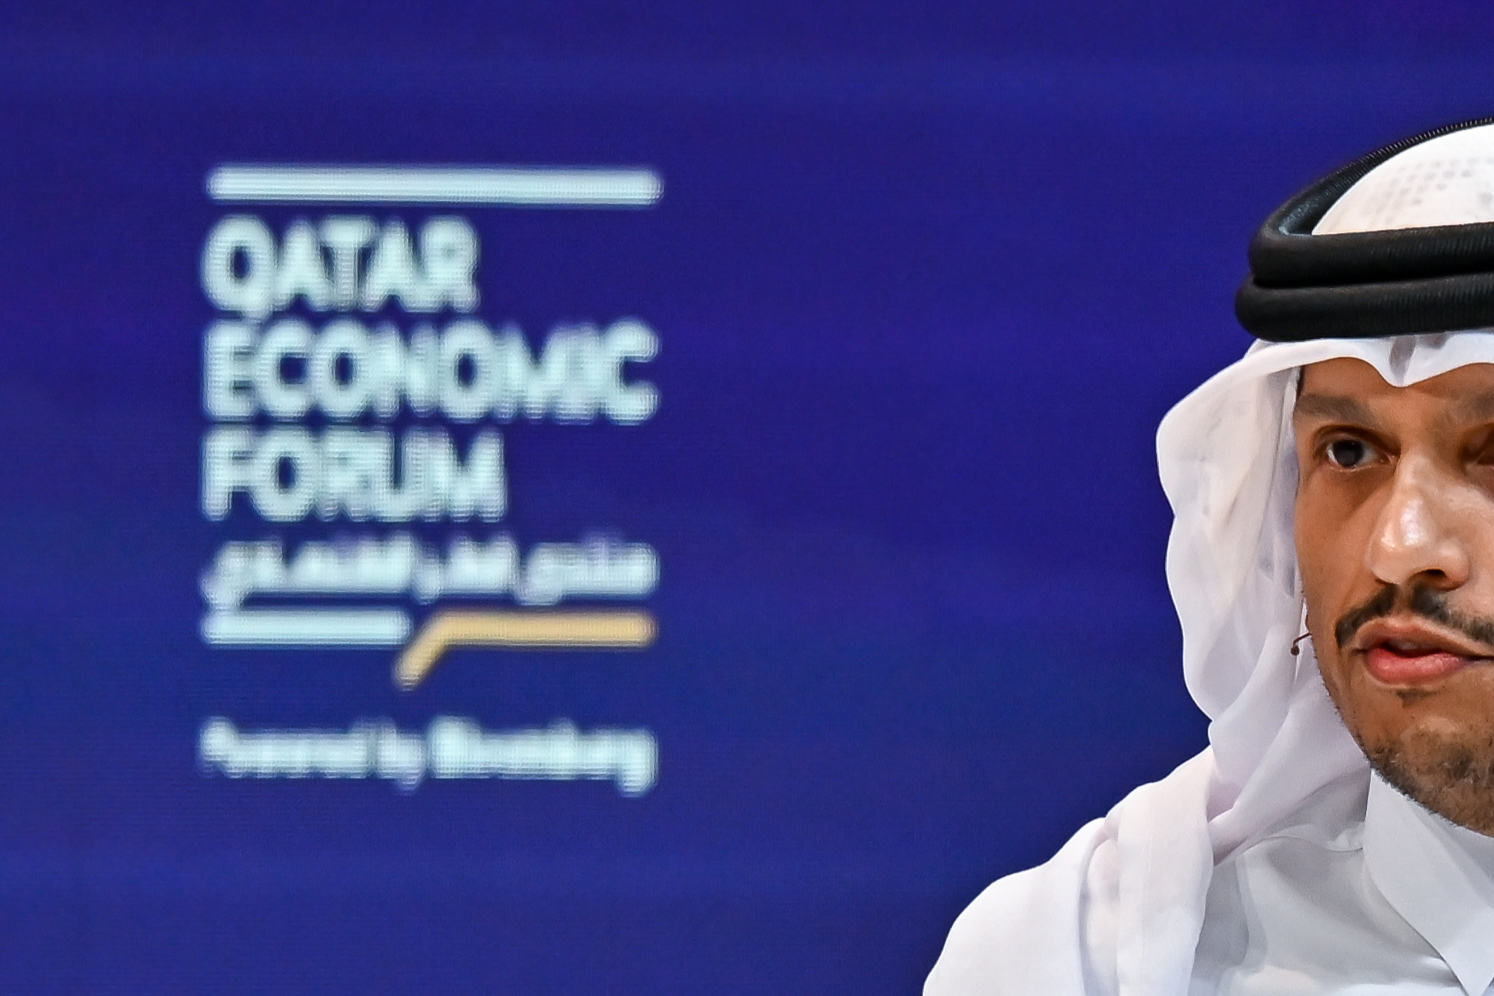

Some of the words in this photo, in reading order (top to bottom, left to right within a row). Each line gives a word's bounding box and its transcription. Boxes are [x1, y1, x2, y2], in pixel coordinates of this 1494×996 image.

[203, 216, 480, 320] QATAR
[203, 319, 658, 424] ECONOMIC
[203, 423, 508, 522] FORUM
